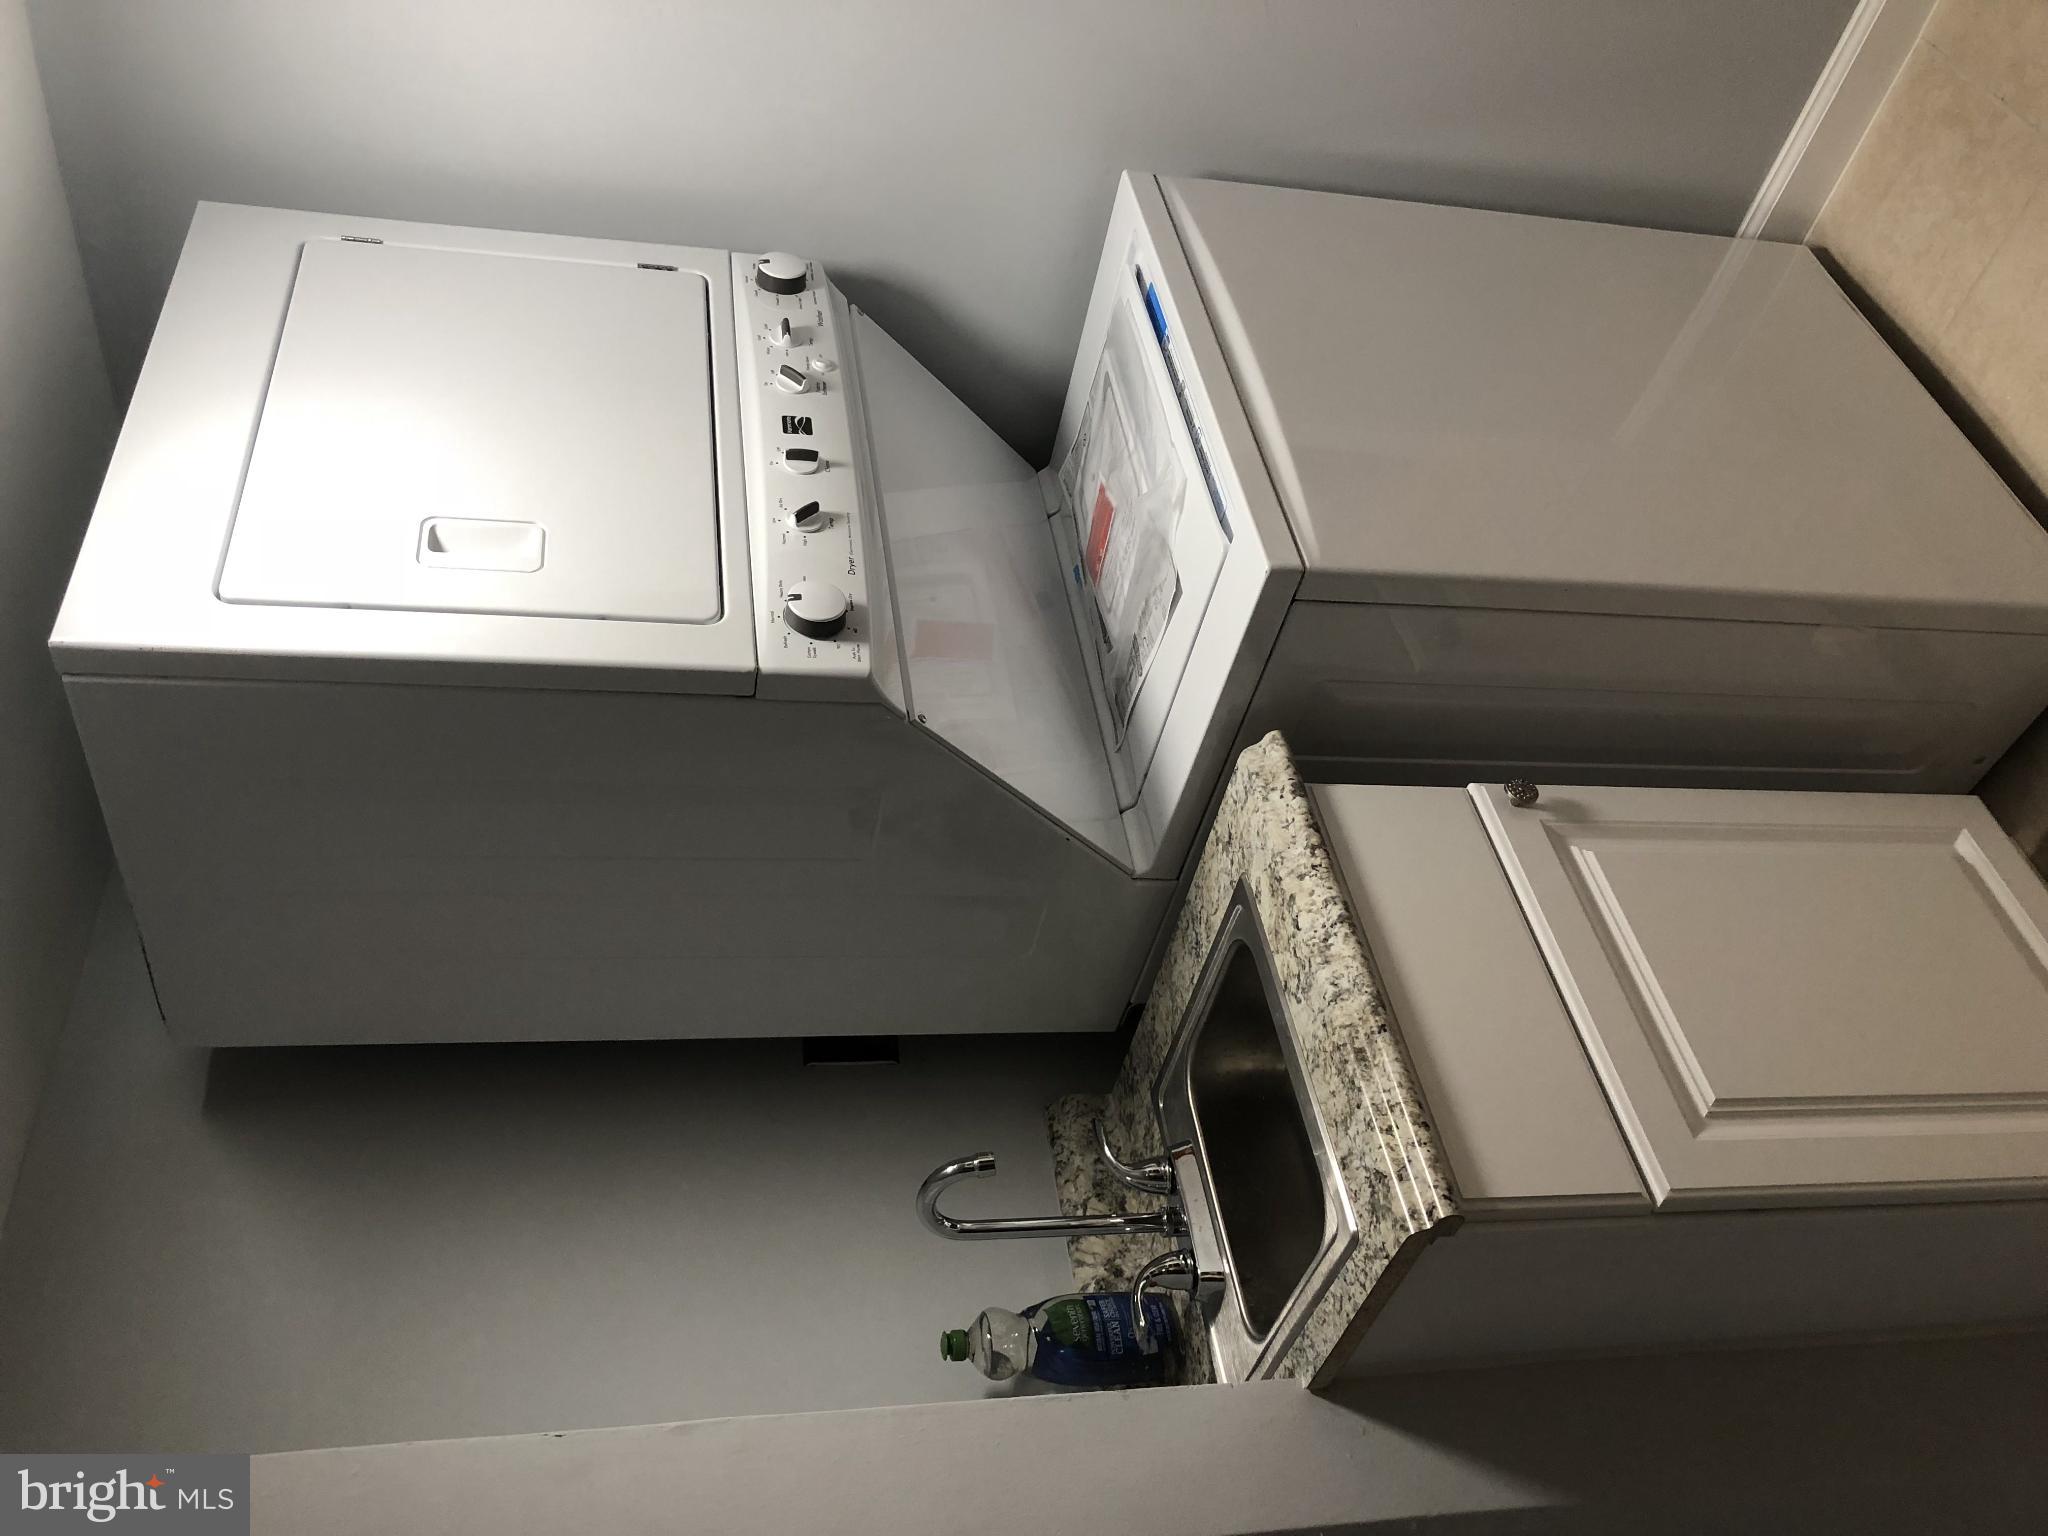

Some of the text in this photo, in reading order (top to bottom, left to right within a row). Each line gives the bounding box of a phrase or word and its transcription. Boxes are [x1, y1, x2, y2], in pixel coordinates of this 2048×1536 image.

[847, 557, 857, 576] Dryer
[1066, 1304, 1082, 1342] seventh
[1111, 1321, 1123, 1354] CLEAN
